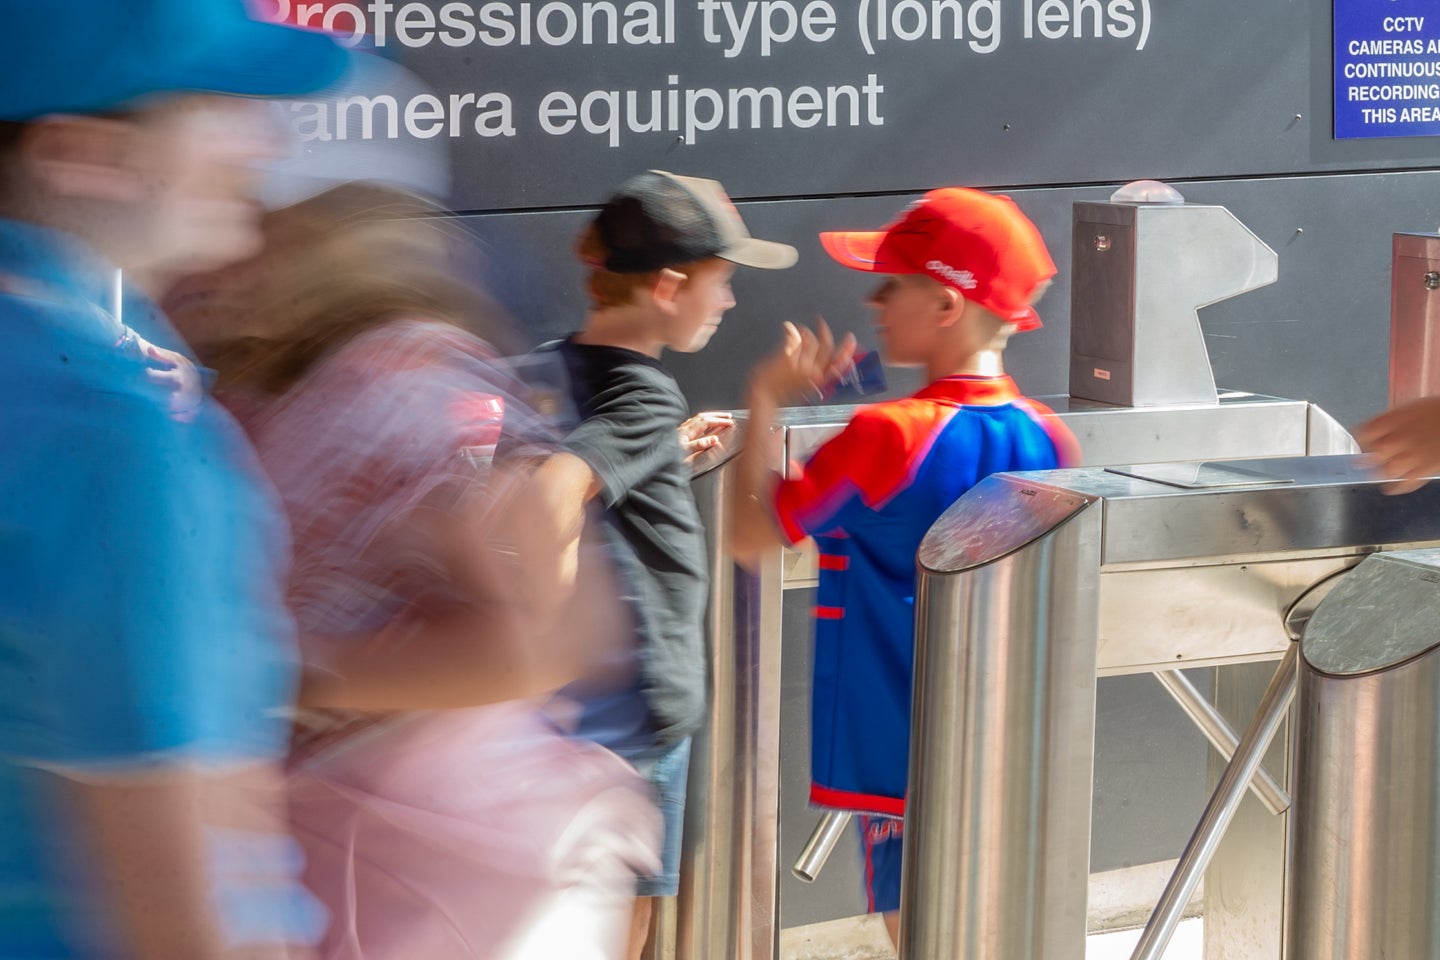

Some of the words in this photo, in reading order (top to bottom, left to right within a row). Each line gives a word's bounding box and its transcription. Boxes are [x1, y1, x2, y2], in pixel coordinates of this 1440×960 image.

[1382, 16, 1425, 33] CCTV
[1348, 40, 1424, 56] CAMERAS
[1348, 85, 1440, 102] RECORDING
[288, 90, 516, 141] amera
[538, 73, 885, 148] equipment
[1361, 108, 1397, 124] THIS
